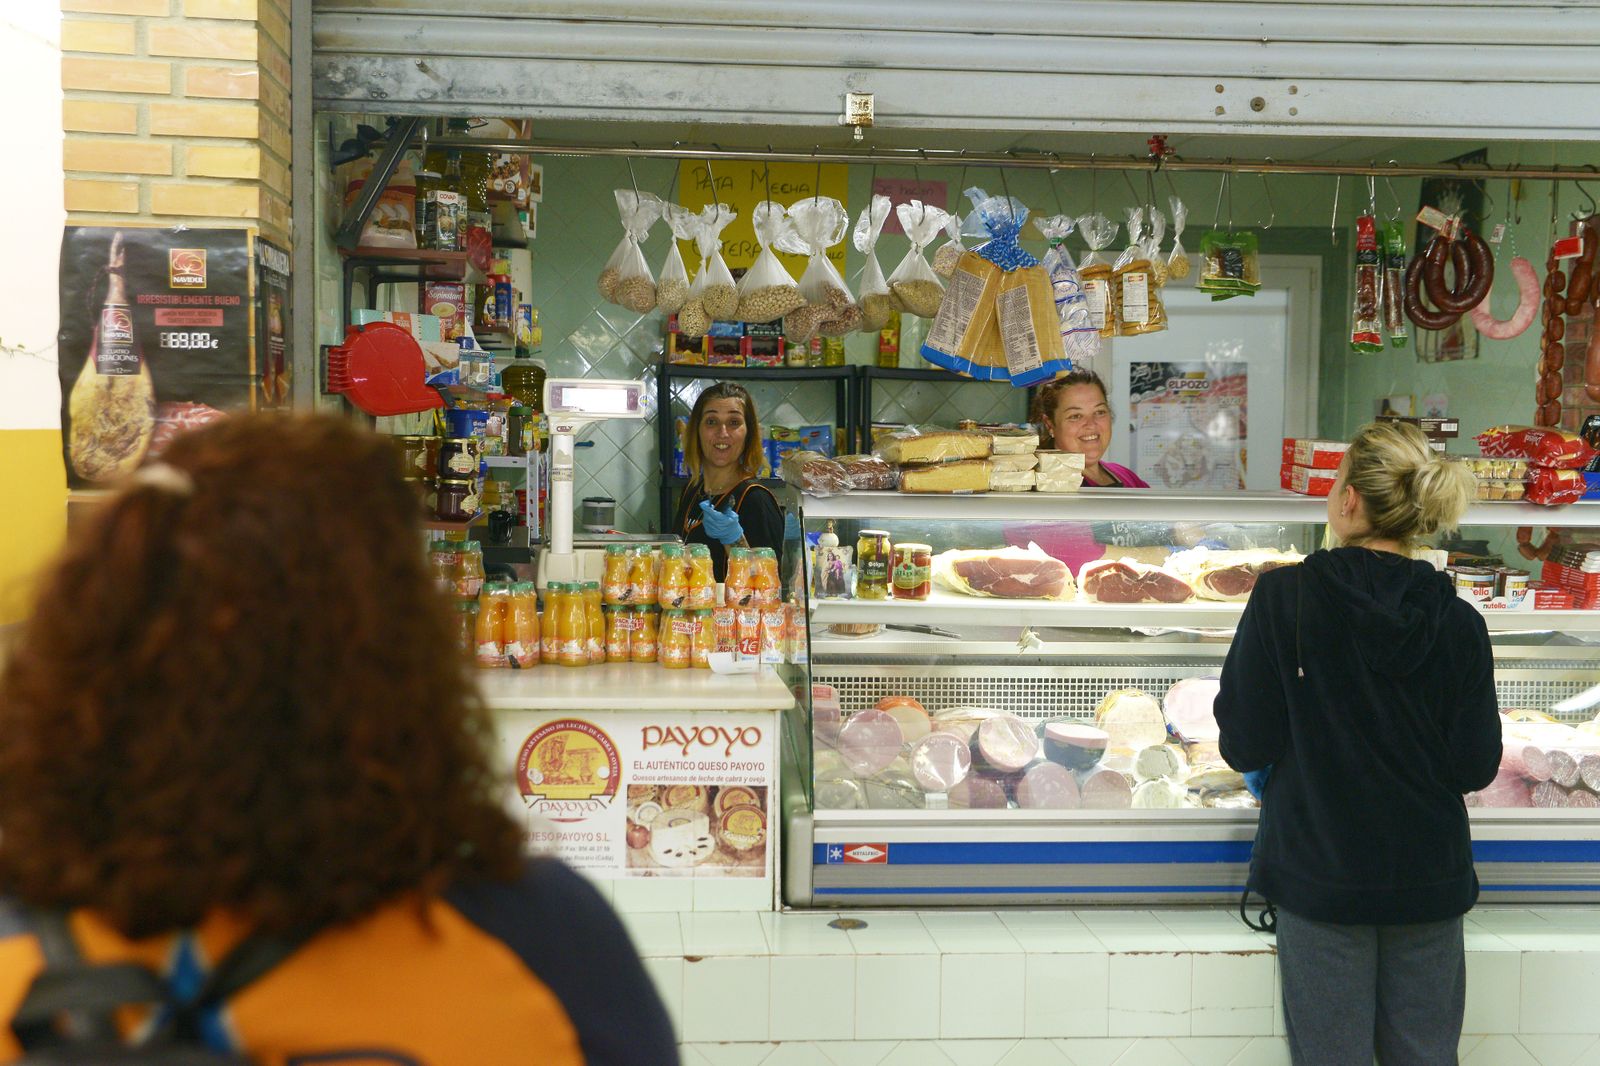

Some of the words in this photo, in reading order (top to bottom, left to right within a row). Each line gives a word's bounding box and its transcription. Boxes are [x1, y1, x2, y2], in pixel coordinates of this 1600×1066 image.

[751, 168, 810, 194] MECHA
[692, 237, 760, 258] ETERA
[137, 295, 213, 305] IRRESISTIBLEMENTE
[215, 296, 240, 305] BUENO
[641, 725, 762, 758] PAYOYO
[633, 761, 644, 770] EL
[646, 759, 696, 770] AUTÉNTICO
[697, 761, 728, 771] QUESO
[730, 762, 765, 771] PAYOYO
[632, 774, 656, 782] Quesos
[540, 801, 598, 817] PAYOYO
[556, 832, 593, 842] PAYOYO
